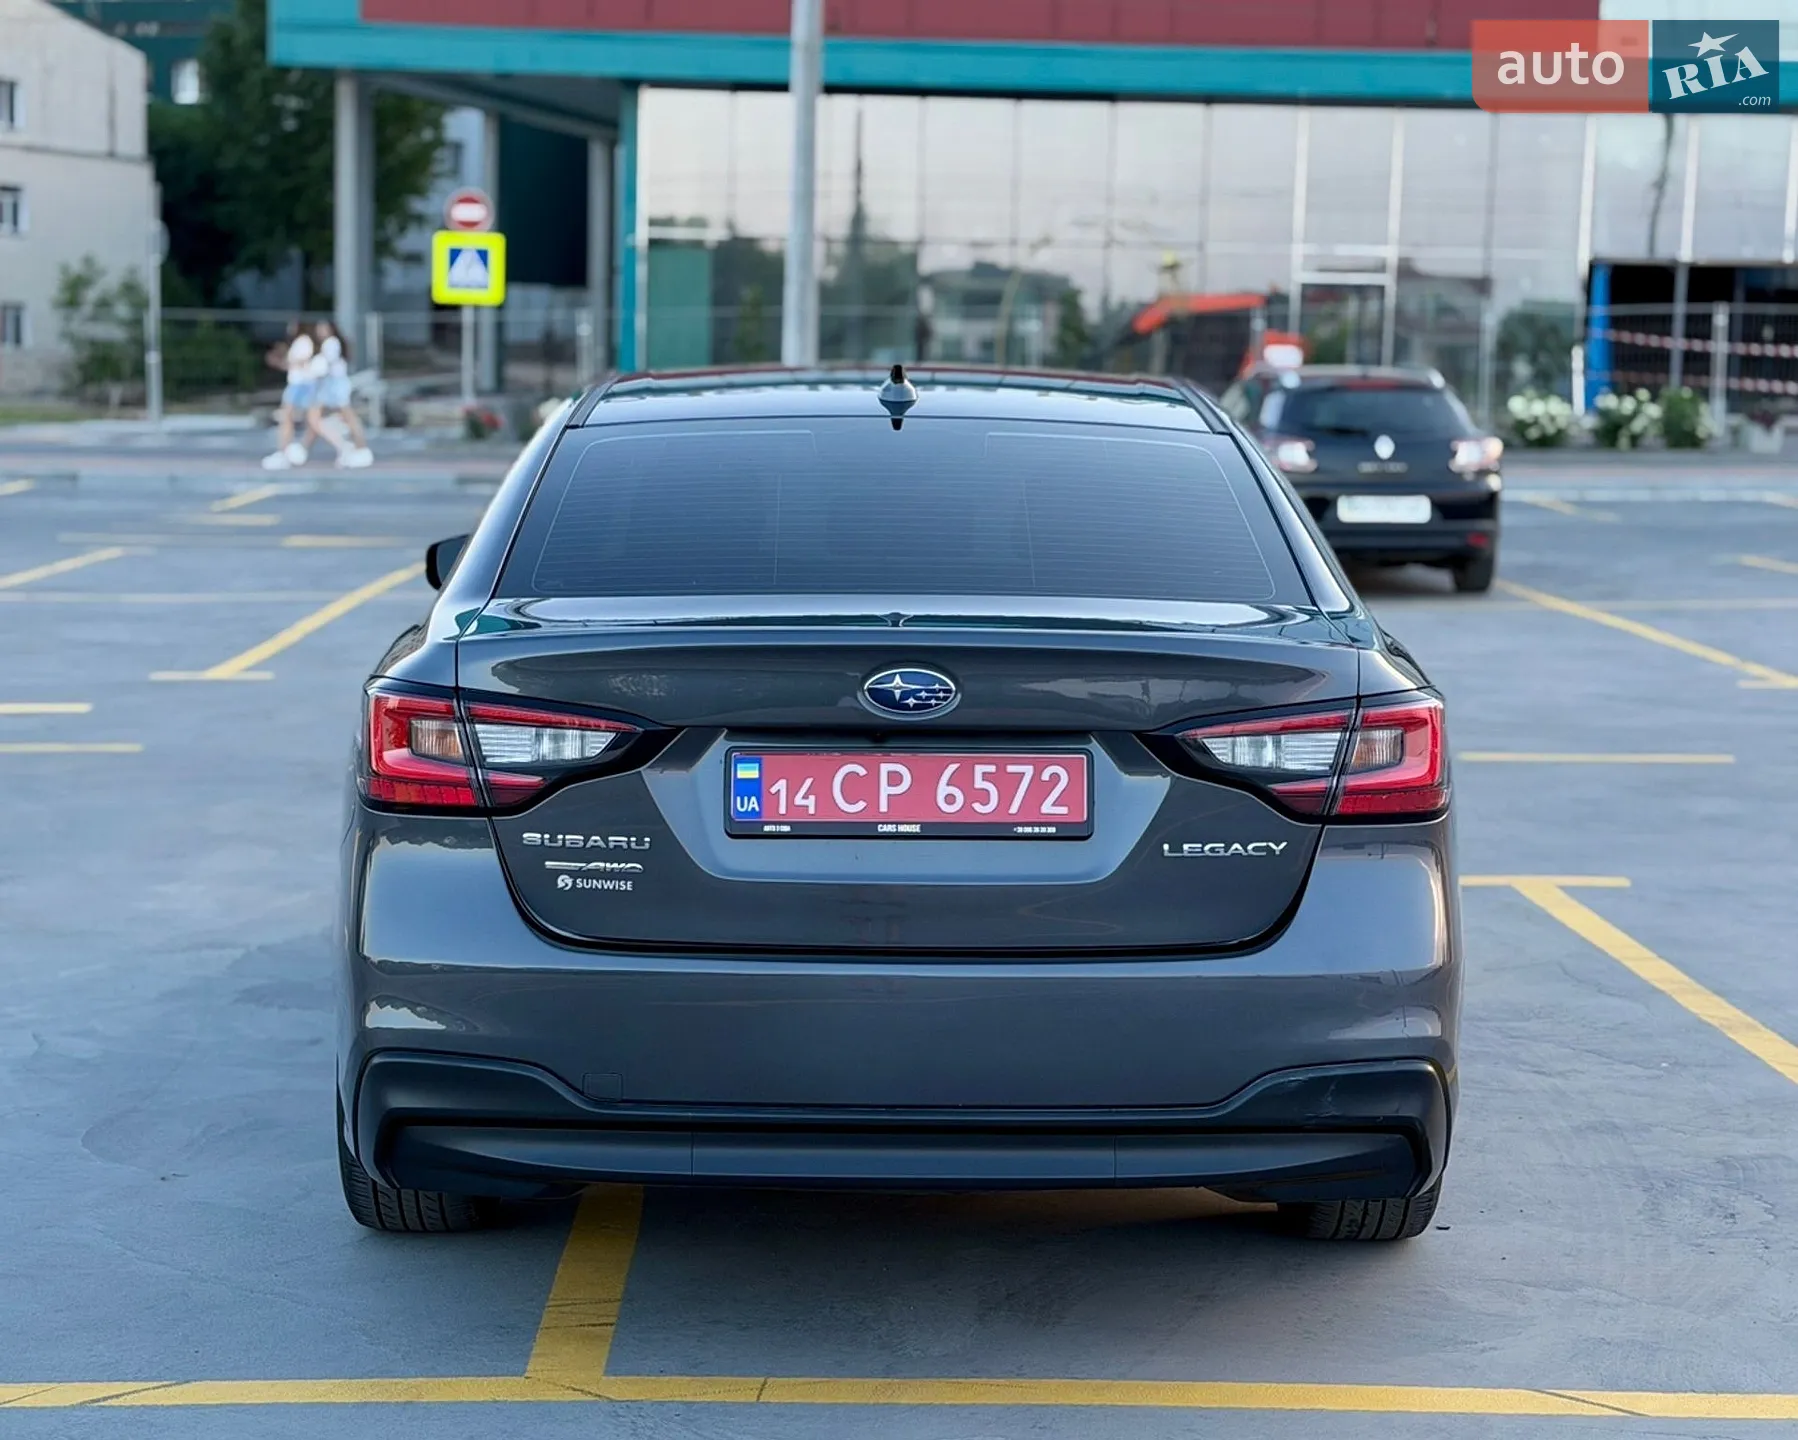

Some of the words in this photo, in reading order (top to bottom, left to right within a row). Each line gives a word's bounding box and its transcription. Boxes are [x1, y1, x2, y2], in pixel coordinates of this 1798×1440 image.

[768, 777, 817, 815] 14
[832, 763, 912, 813] CP
[936, 763, 1069, 815] 6572
[736, 796, 760, 812] UA
[877, 823, 897, 832] CARS
[898, 823, 921, 833] HOUSE
[522, 832, 650, 850] SUBARU
[1163, 841, 1288, 857] LEGACY
[580, 861, 644, 873] AWD
[575, 877, 633, 891] SUNWISE
